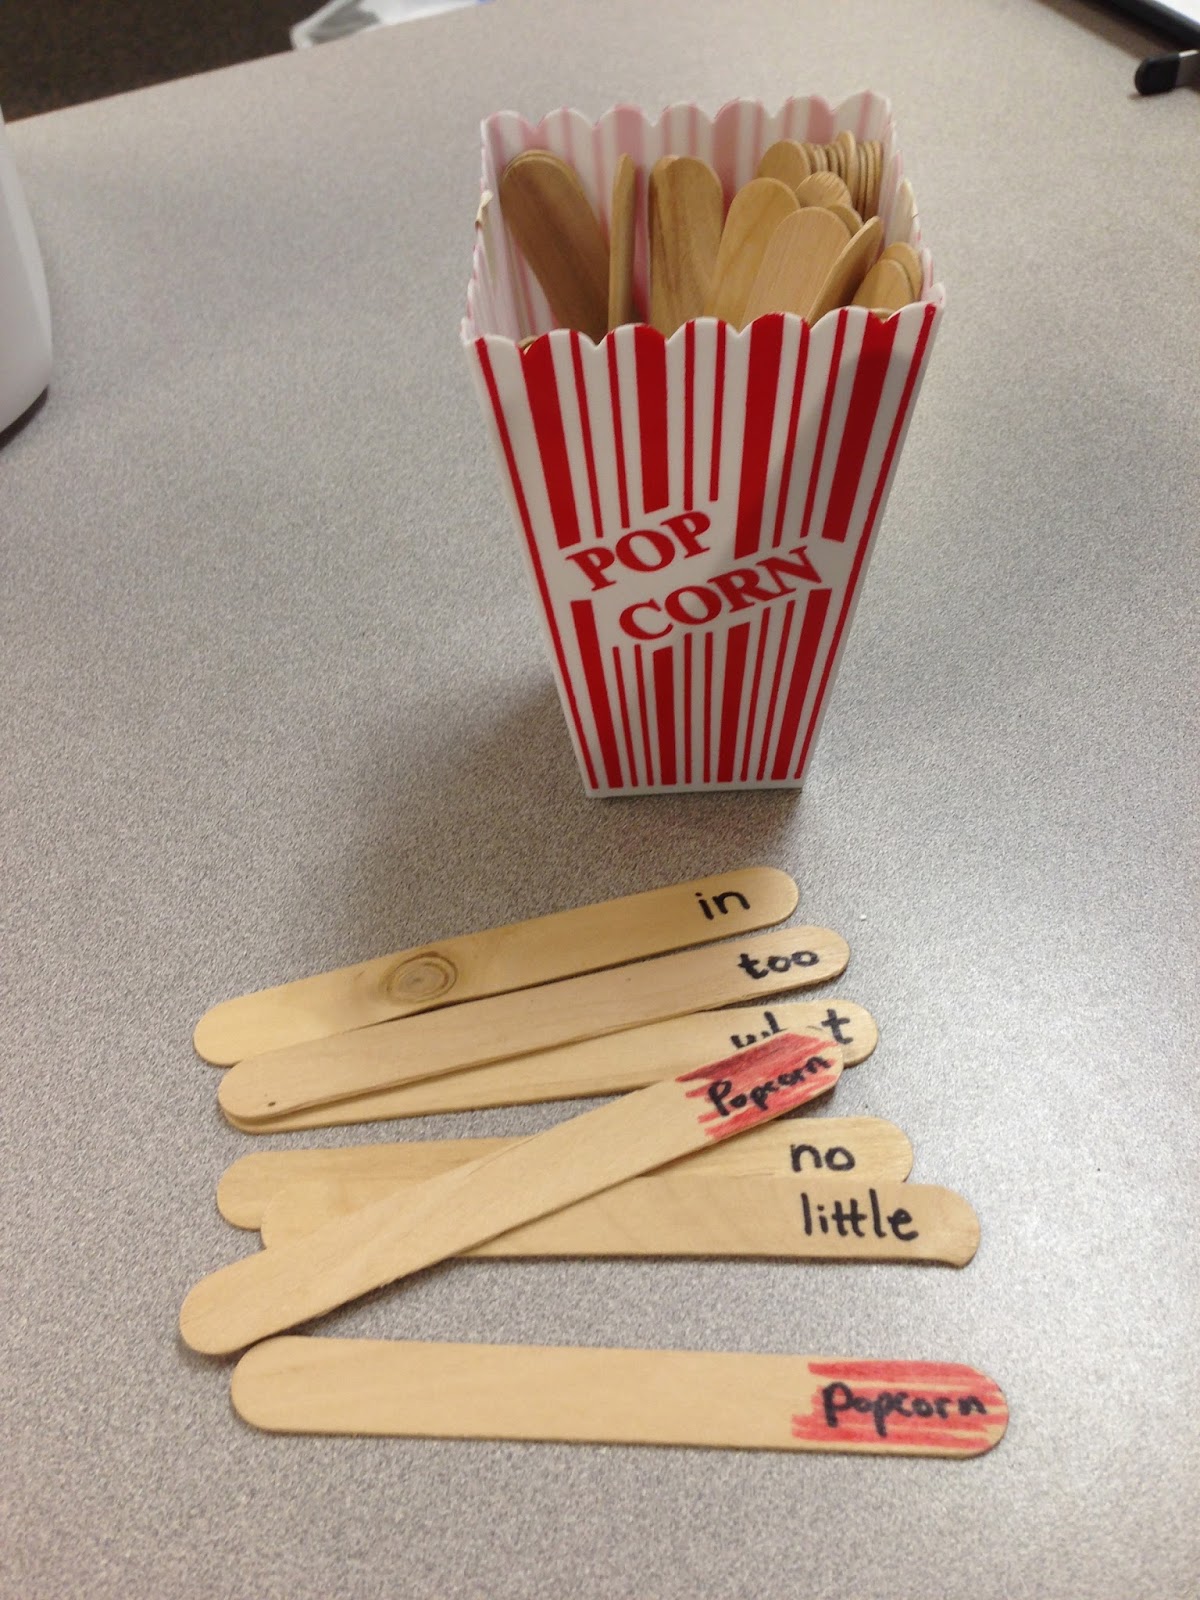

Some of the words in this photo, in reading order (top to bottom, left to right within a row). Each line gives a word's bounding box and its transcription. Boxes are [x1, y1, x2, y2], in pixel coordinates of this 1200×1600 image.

[565, 511, 711, 591] POP
[619, 545, 822, 640] CORN
[695, 891, 750, 920] in
[737, 950, 820, 979] too
[790, 1143, 855, 1172] no
[801, 1188, 919, 1241] little
